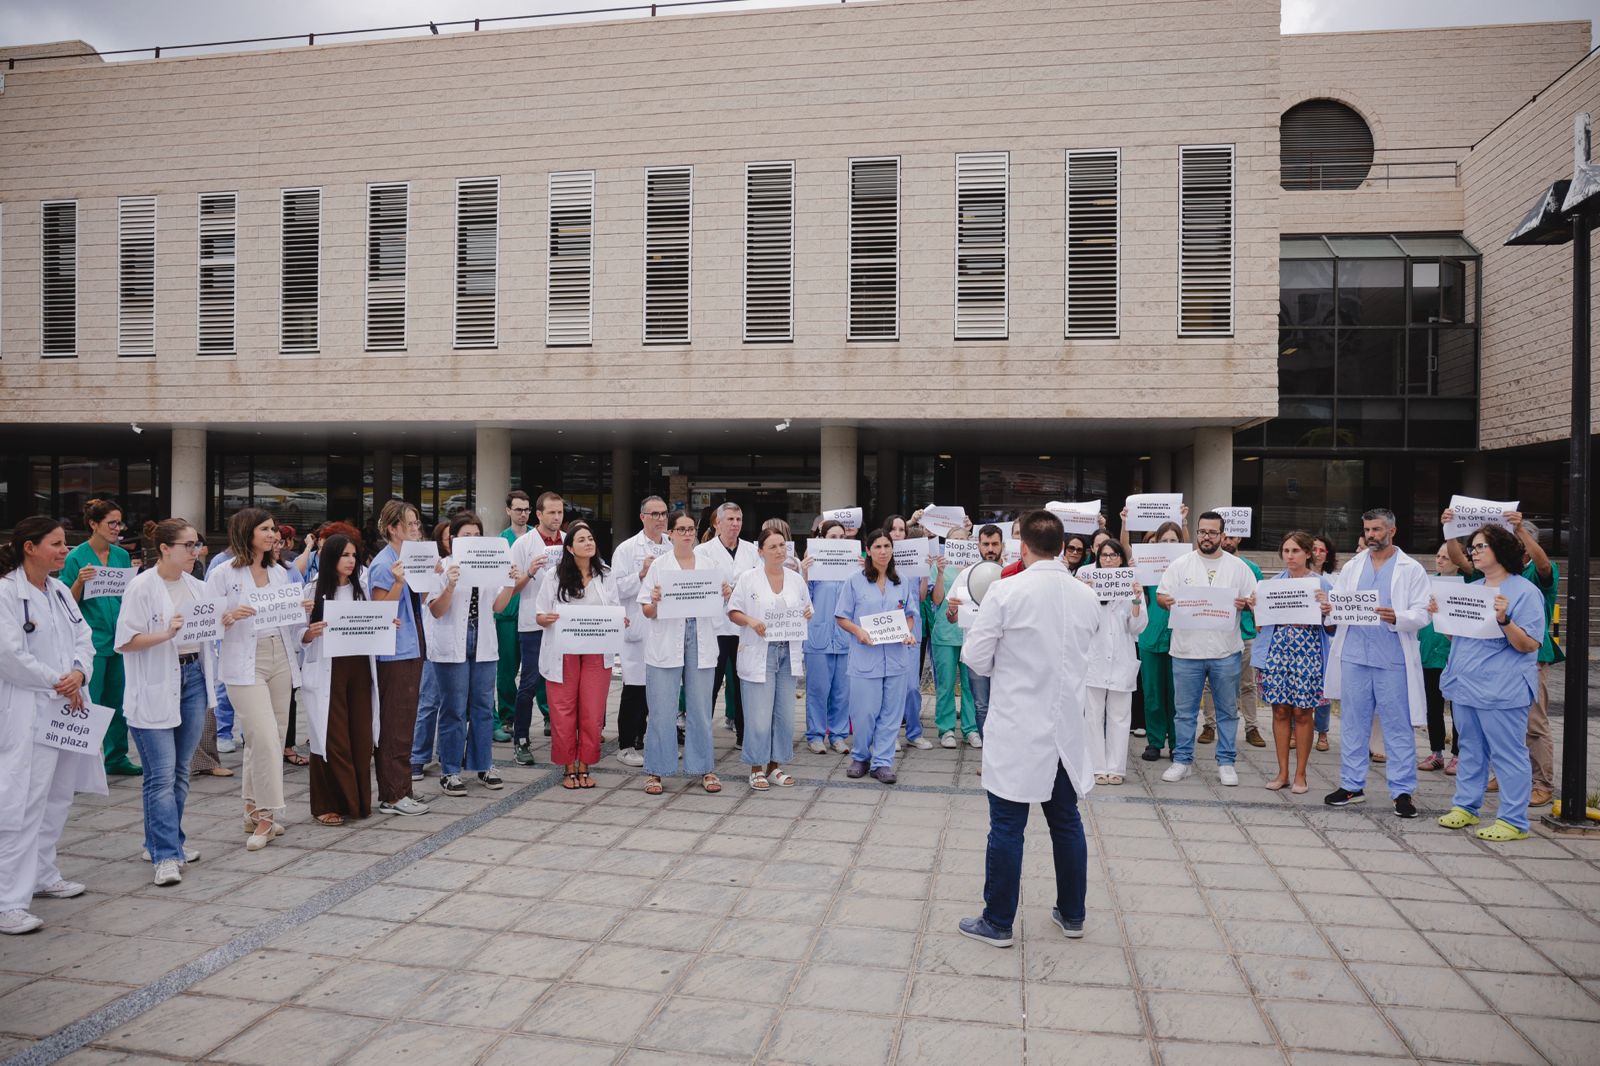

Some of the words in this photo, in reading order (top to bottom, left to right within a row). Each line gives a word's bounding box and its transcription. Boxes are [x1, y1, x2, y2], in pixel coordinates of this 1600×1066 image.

[1454, 504, 1477, 514] Stop
[1480, 506, 1502, 514] SCS
[946, 541, 965, 550] Stop
[99, 570, 124, 578] SCS
[1092, 571, 1113, 580] Stop
[1115, 570, 1134, 579] SCS
[250, 592, 276, 602] Stop
[278, 587, 300, 598] SCS
[1330, 594, 1352, 604] Stop
[1354, 594, 1376, 602] SCS
[193, 603, 214, 616] SCS
[258, 604, 266, 613] la
[268, 602, 286, 611] OPE
[279, 612, 302, 623] juego
[764, 611, 784, 620] Stop
[786, 610, 805, 618] SCS
[1356, 614, 1377, 622] juego
[200, 618, 215, 627] deja
[873, 615, 893, 626] SCS
[183, 632, 195, 640] sin
[196, 630, 216, 640] plaza
[784, 630, 804, 638] juego
[60, 704, 90, 719] SCS
[51, 720, 65, 729] me
[66, 722, 90, 735] deja
[46, 732, 58, 742] sin
[60, 736, 88, 748] plaza
